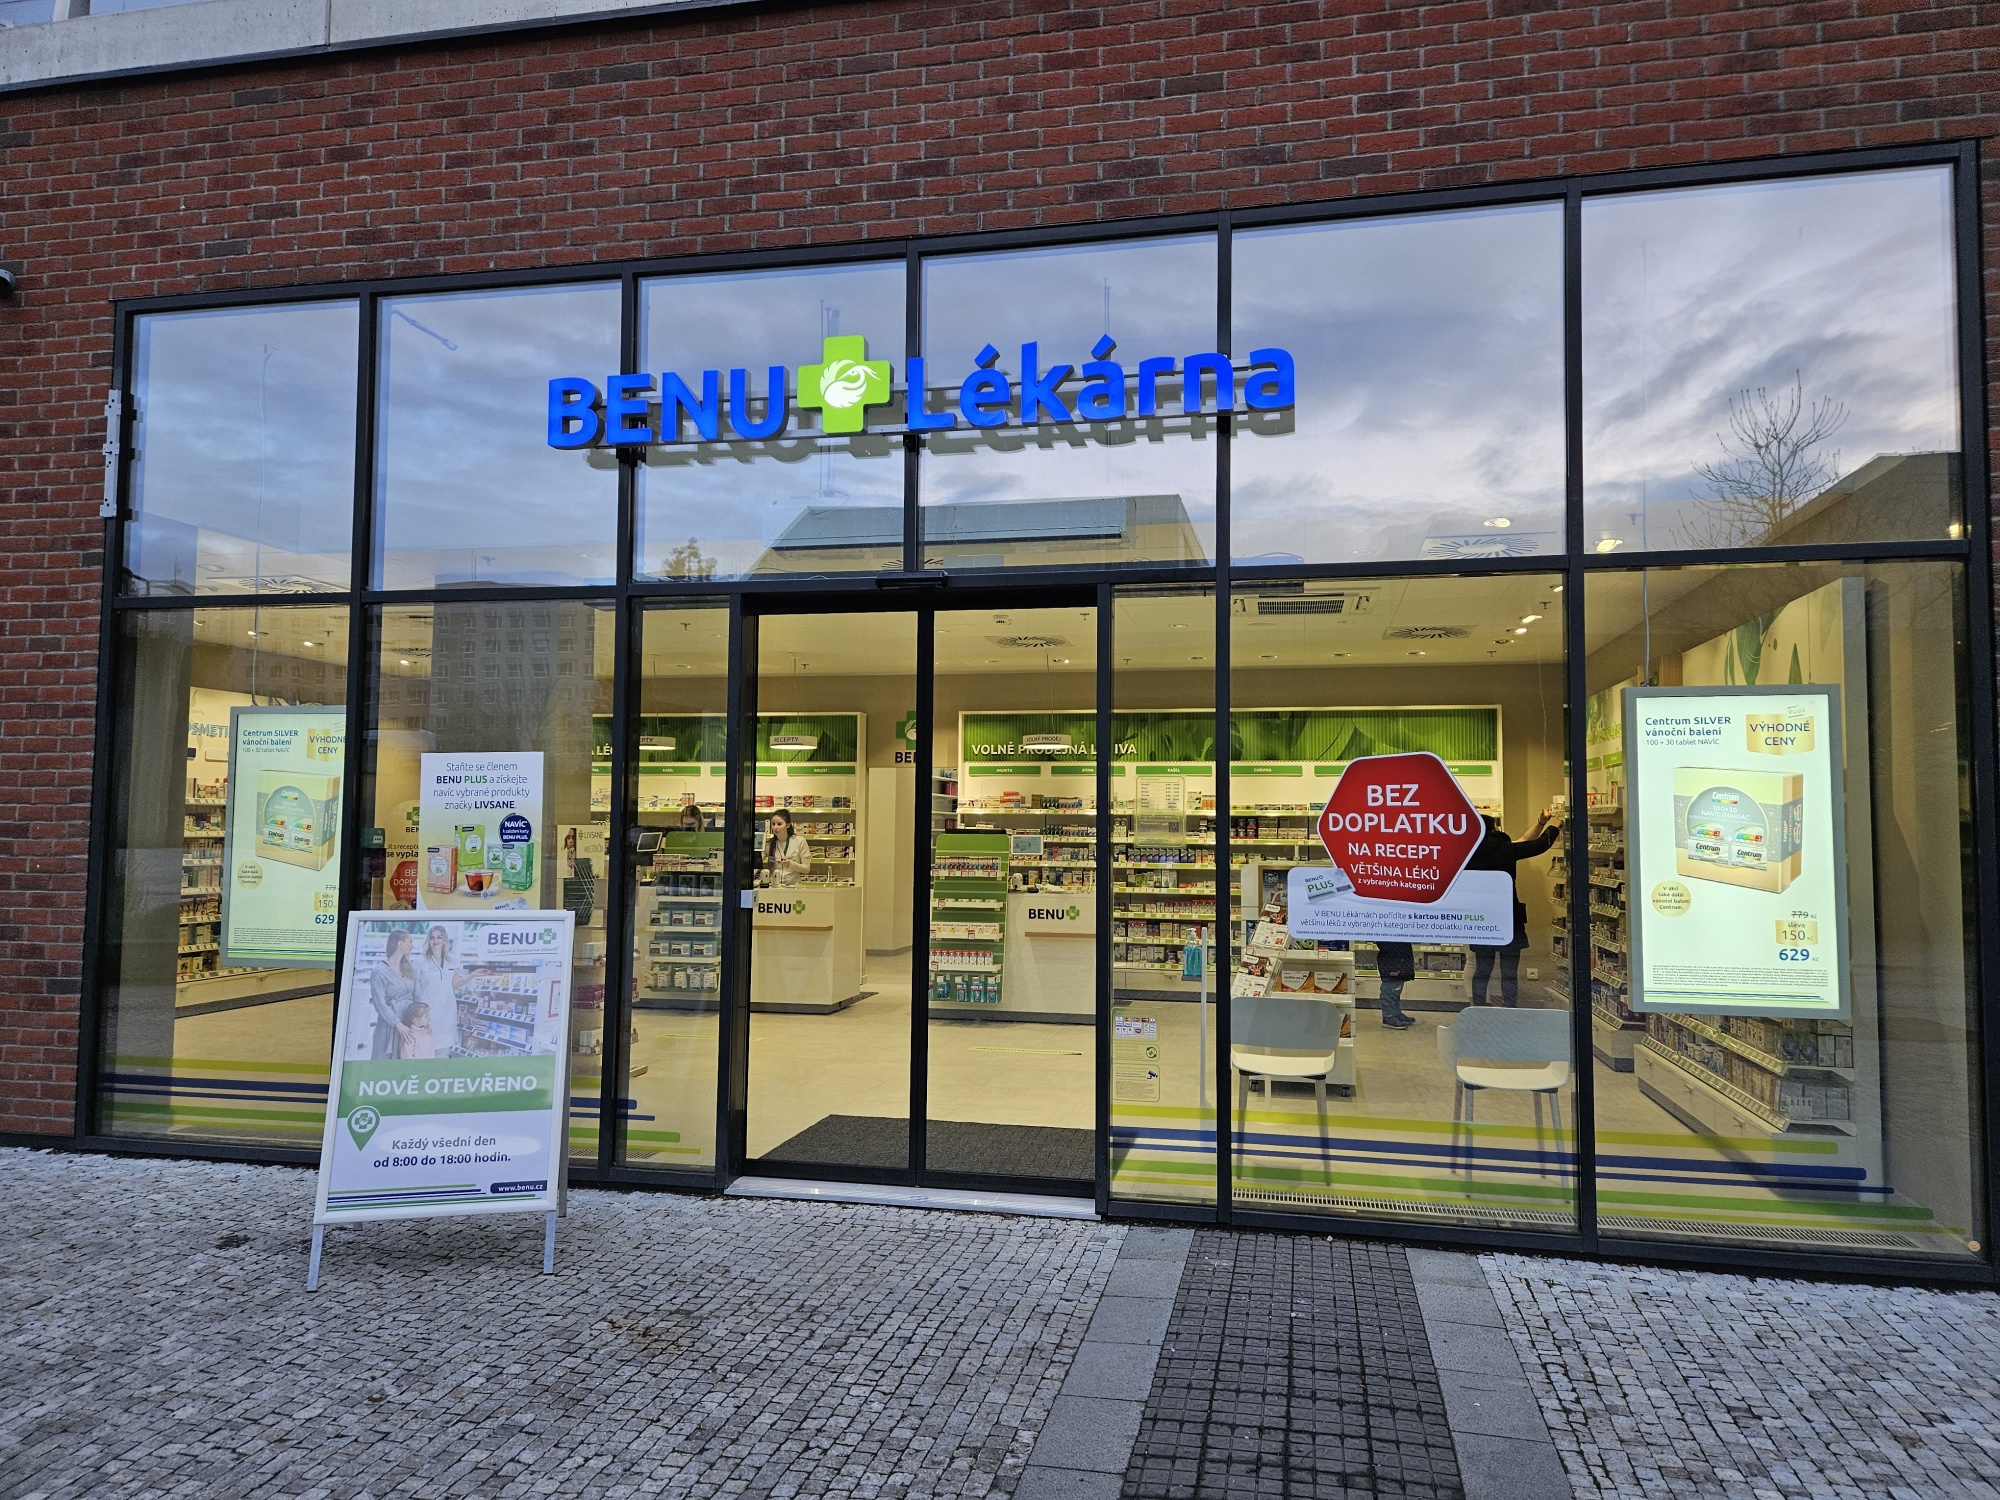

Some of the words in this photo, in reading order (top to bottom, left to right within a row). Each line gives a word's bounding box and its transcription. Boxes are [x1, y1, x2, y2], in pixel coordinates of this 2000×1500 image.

[548, 366, 786, 448] BENU
[907, 333, 1296, 430] Lékárna
[1645, 717, 1691, 726] Centrum
[1693, 716, 1731, 725] SILVER
[1750, 721, 1811, 733] VÝHODNÉ
[1645, 727, 1686, 736] vánoční
[1689, 726, 1722, 736] balení
[1764, 737, 1796, 746] CENY
[596, 743, 612, 755] LÉ
[972, 742, 1014, 755] VOLNĚ
[446, 762, 474, 771] Staňte
[487, 762, 517, 770] členem
[496, 775, 527, 785] získejte
[434, 788, 454, 796] navíc
[456, 787, 490, 798] vybrané
[492, 787, 530, 798] produkty
[1367, 784, 1420, 807] BEZ
[1712, 792, 1739, 800] Centrum
[445, 800, 472, 811] značky
[1329, 813, 1467, 835] DOPLATKU
[1348, 843, 1371, 857] NA
[1375, 843, 1441, 860] RECEPT
[1696, 843, 1720, 853] Centrum
[1737, 850, 1762, 858] Centrum
[1351, 861, 1402, 877] VĚTŠINA
[1406, 865, 1440, 880] LÉKŮ
[1307, 879, 1334, 893] PLUS
[1363, 878, 1399, 887] vybraných
[1400, 880, 1435, 890] kategorií
[318, 900, 333, 908] 150
[758, 903, 791, 913] BENU
[315, 914, 335, 924] 629
[1028, 908, 1064, 920] BENU
[1342, 911, 1378, 919] Lékárnách
[1379, 912, 1406, 921] pořídíte
[1326, 919, 1341, 927] léků
[1348, 920, 1382, 929] vybraných
[1384, 921, 1415, 930] kategorií
[1431, 922, 1462, 931] doplatku
[488, 932, 536, 945] BENU
[1782, 930, 1805, 940] 150
[1779, 948, 1810, 961] 629
[359, 1075, 419, 1096] NOVĚ
[425, 1072, 537, 1095] OTEVŘENO
[392, 1138, 428, 1150] Každý
[432, 1136, 471, 1148] všední
[474, 1136, 496, 1146] den
[374, 1157, 389, 1168] od
[392, 1156, 418, 1167] 8:00
[421, 1155, 436, 1166] do
[440, 1154, 471, 1164] 18:00
[475, 1152, 511, 1163] hodin.
[498, 1184, 543, 1192] www.benu.cz
